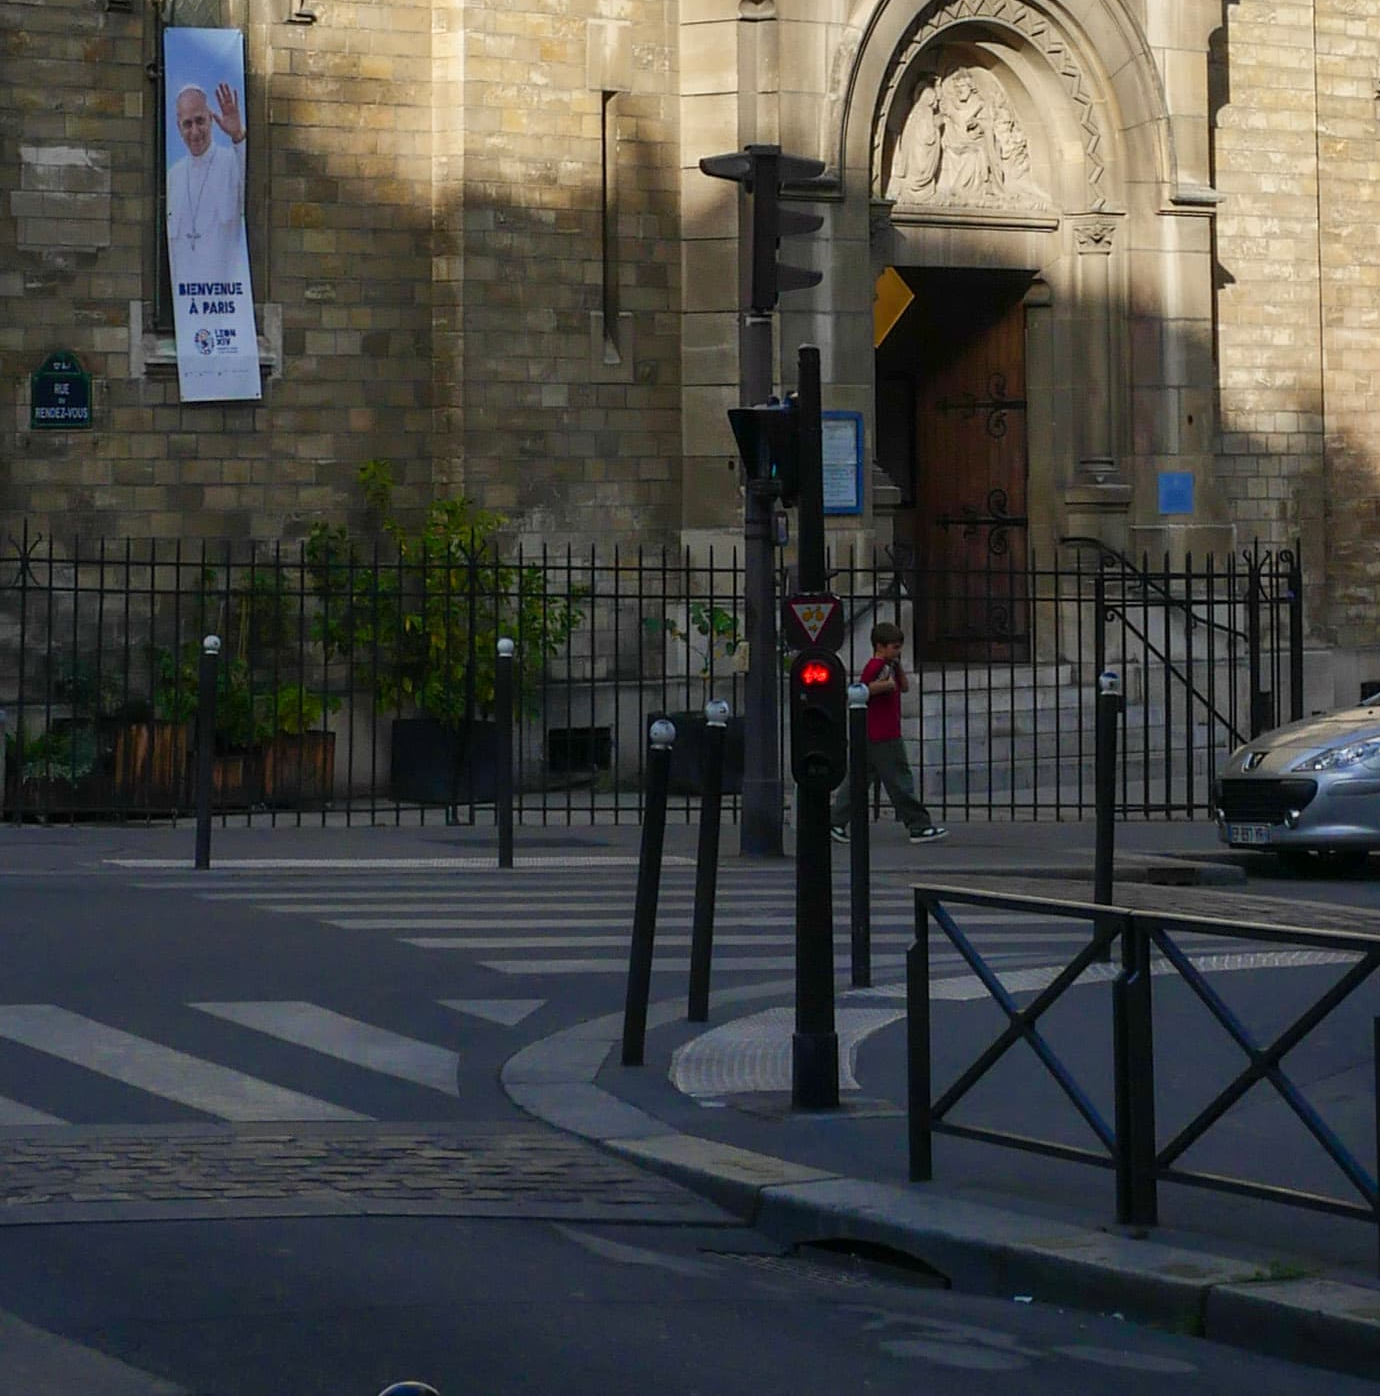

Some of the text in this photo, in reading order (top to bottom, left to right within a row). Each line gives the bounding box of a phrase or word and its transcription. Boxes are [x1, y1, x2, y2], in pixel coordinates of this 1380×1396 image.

[178, 282, 243, 296] BIENVENUE
[189, 298, 236, 315] À PARIS
[54, 383, 70, 395] RUE
[35, 407, 88, 419] RENDEZ-VOUS
